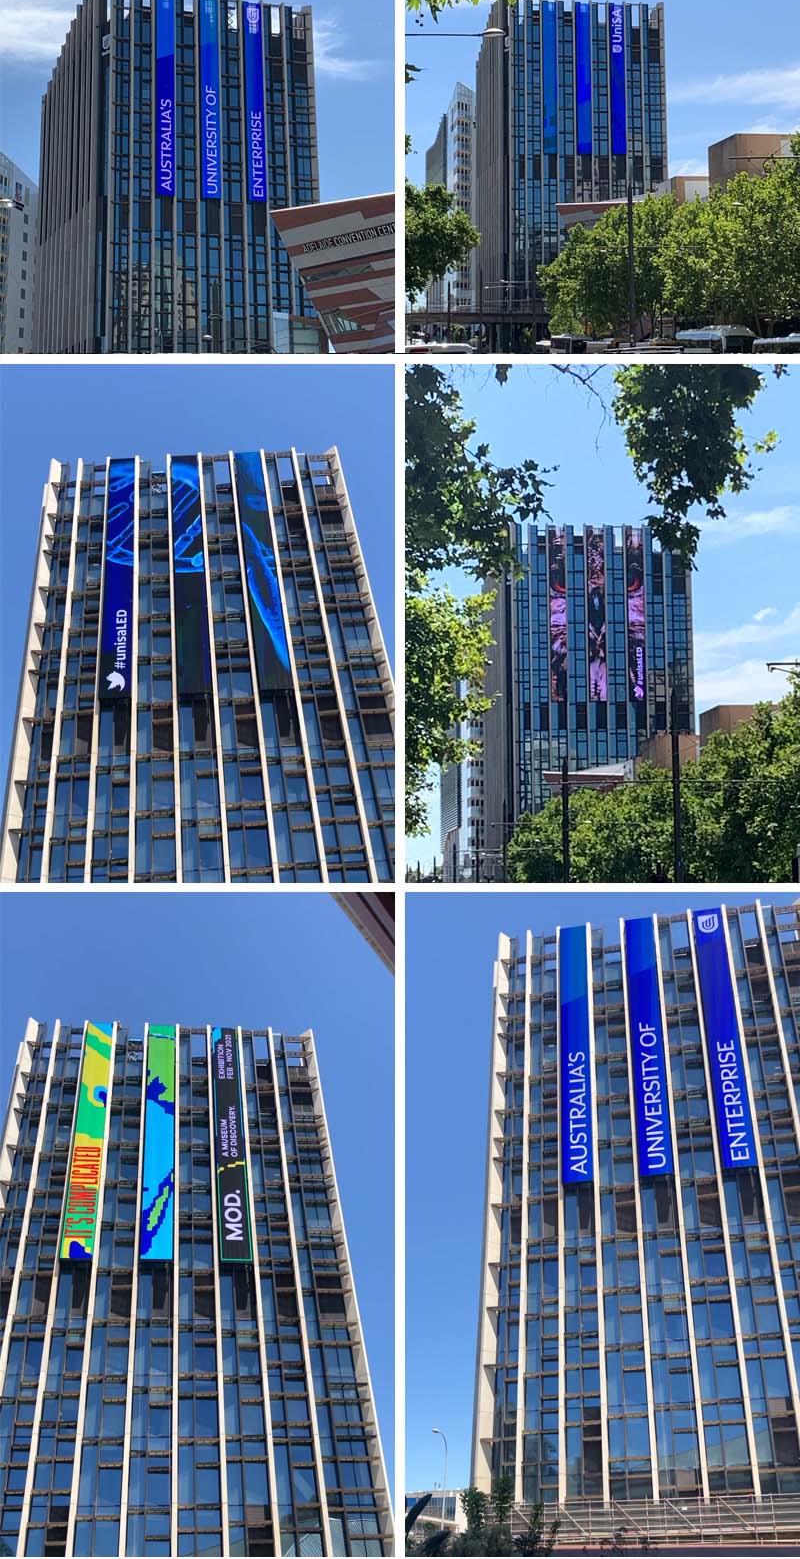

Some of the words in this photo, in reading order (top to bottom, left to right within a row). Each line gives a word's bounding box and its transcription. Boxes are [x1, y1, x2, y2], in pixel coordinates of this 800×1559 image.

[611, 8, 622, 43] UniSA
[205, 85, 217, 106] OF
[160, 98, 172, 192] AUSTRALIA'S
[205, 108, 218, 195] UNIVERSITY
[250, 111, 264, 198] ENTERPRISE
[334, 227, 378, 248] CONVENTION
[114, 609, 127, 670] #unisaLED
[639, 1022, 657, 1048] OF
[217, 1043, 226, 1080] EXHIBITION
[226, 1067, 234, 1080] FEB
[568, 1051, 588, 1175] AUSTRALIA'S
[640, 1052, 667, 1170] UNIVERSITY
[717, 1039, 750, 1162] ENTERPRISE
[221, 1119, 229, 1150] MUSEUM
[230, 1146, 239, 1158] OF
[221, 1149, 230, 1158] A
[67, 1146, 101, 1214] COMPLICATED
[64, 1217, 95, 1239] IT'S
[224, 1189, 244, 1241] MOD.
